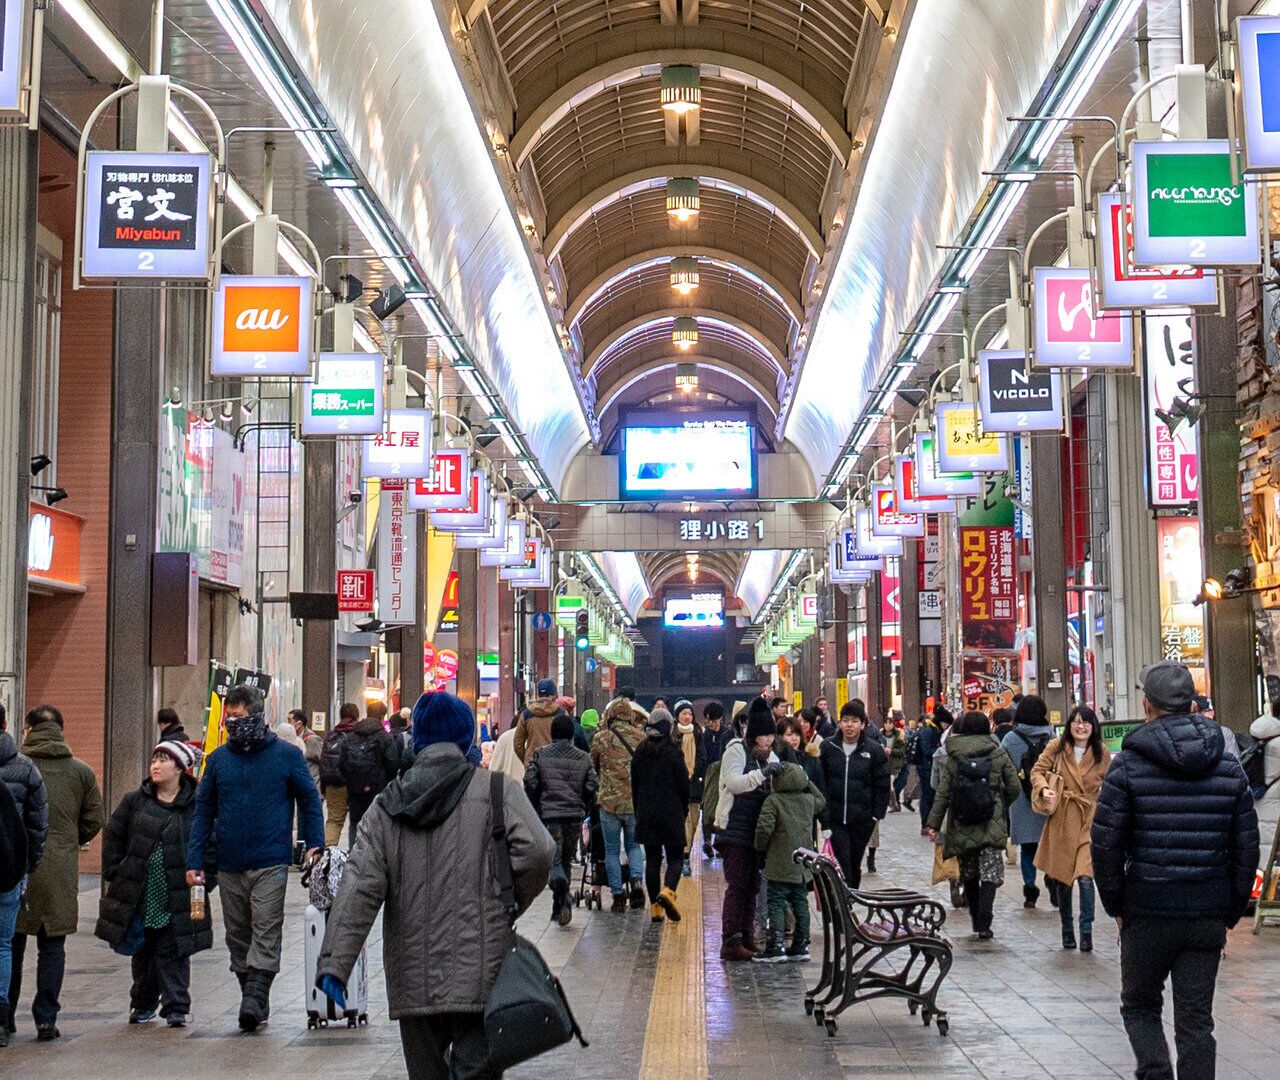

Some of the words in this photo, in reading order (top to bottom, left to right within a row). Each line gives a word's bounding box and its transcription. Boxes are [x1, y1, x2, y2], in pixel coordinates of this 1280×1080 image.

[106, 186, 193, 221] 宮文
[115, 227, 182, 242] Miyabun
[1190, 240, 1206, 258] 2
[138, 251, 154, 270] 2
[1153, 283, 1167, 299] 2
[235, 308, 289, 330] au
[1078, 345, 1091, 360] 2
[253, 354, 267, 369] 2
[993, 388, 1049, 399] VICOLO
[313, 393, 373, 411] 業務スーパー
[336, 419, 351, 429] 2
[1017, 414, 1027, 426] 2
[374, 431, 420, 447] 紅屋
[391, 463, 400, 473] 2
[969, 458, 979, 467] 2
[1157, 426, 1177, 500] 女性専用
[945, 482, 954, 491] 2
[434, 497, 442, 505] 2
[391, 492, 404, 618] 東京靴流通センター
[964, 531, 989, 619] ロウリュ
[342, 575, 364, 598] 靴
[927, 594, 938, 608] 串
[968, 697, 989, 710] 5F
